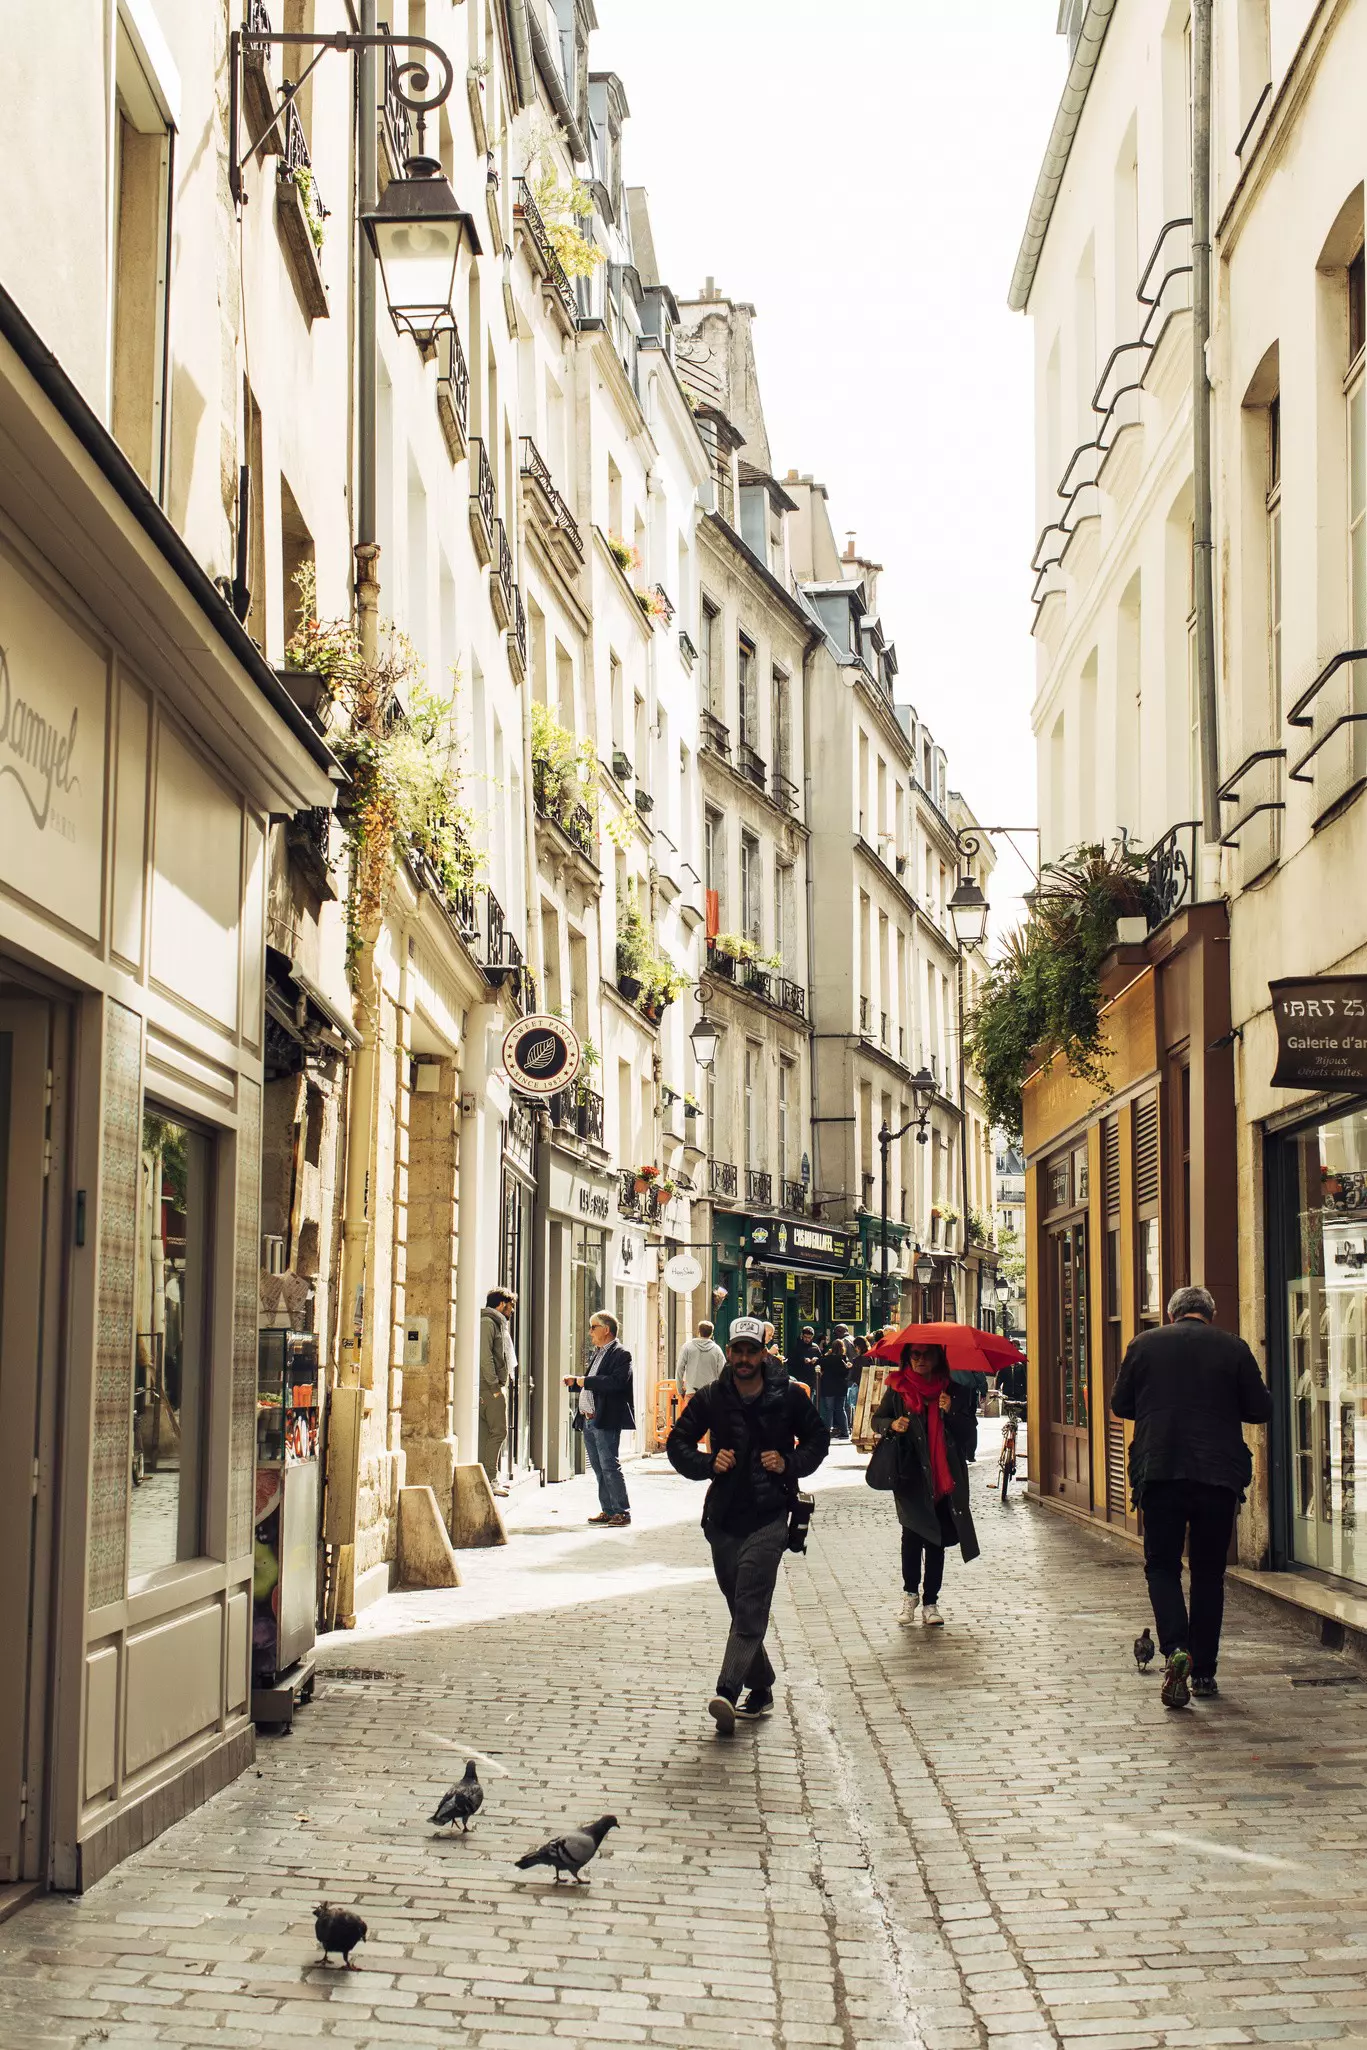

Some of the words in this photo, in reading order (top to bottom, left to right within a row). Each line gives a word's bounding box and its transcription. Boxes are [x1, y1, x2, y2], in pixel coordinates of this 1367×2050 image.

[512, 1020, 543, 1040] SWEET
[548, 1021, 574, 1047] PANTS
[1287, 1036, 1338, 1049] Galerie
[1315, 1056, 1348, 1067] Bijoux
[1297, 1067, 1328, 1078] Objets
[513, 1071, 539, 1089] SINCE
[544, 1077, 563, 1089] 1982
